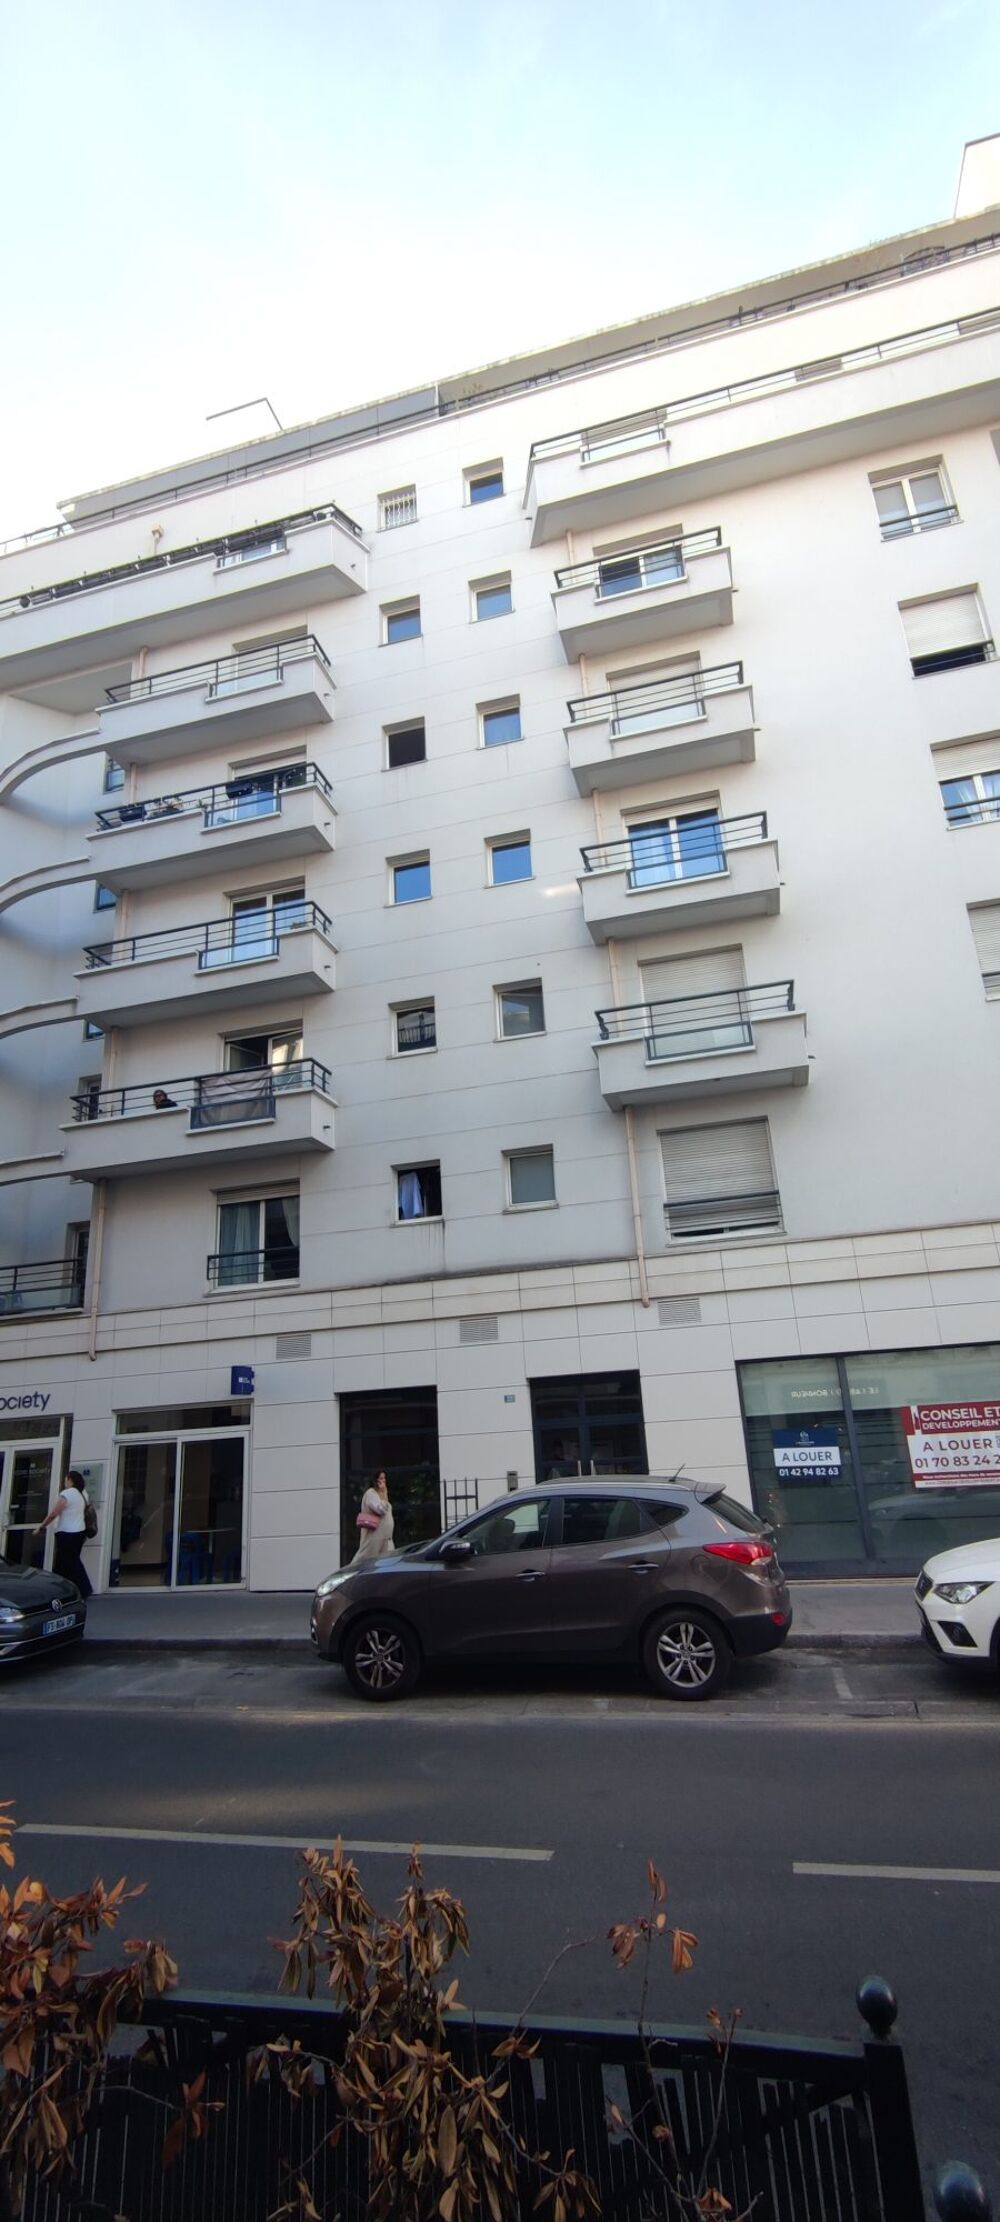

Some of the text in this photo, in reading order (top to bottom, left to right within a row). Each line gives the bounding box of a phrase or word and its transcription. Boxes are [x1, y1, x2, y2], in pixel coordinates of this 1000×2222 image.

[920, 1406, 1000, 1421] CONSEIL ET
[923, 1438, 993, 1452] A LOUER
[782, 1451, 832, 1462] A LOUER
[915, 1458, 928, 1468] 01
[932, 1457, 949, 1468] 70
[953, 1456, 970, 1466] 83
[973, 1455, 991, 1465] 24
[779, 1467, 839, 1476] 01 42 94 82 63
